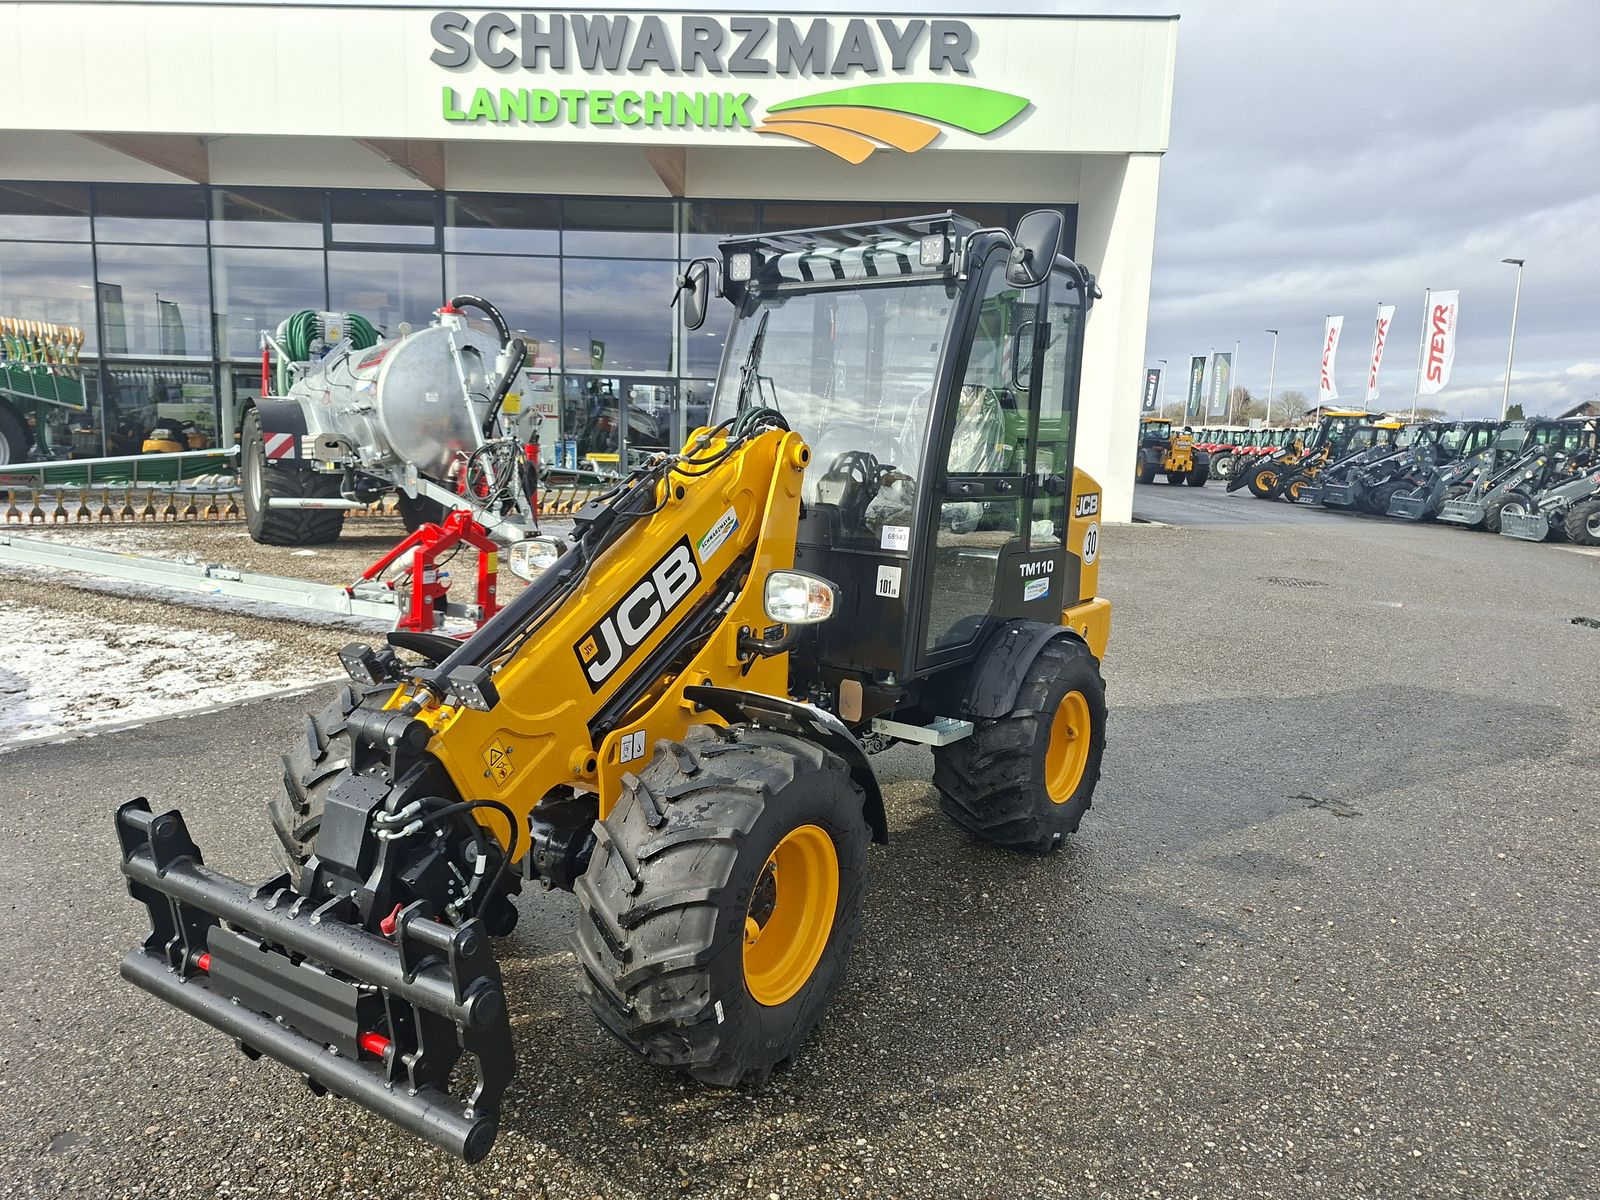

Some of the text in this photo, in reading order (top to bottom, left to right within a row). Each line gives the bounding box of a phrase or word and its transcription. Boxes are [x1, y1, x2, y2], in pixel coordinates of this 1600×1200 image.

[429, 10, 976, 75] SCHWARZMAYR
[441, 86, 754, 128] LANDTECHNIK
[1320, 327, 1338, 391] STEYR
[1369, 318, 1388, 389] STEYR
[1426, 304, 1449, 385] STEYR
[536, 403, 554, 413] NEU
[1075, 494, 1099, 516] JCB
[701, 516, 731, 549] SCHWARZMAYR
[1085, 530, 1097, 556] 30
[880, 579, 892, 594] 101
[1019, 560, 1054, 577] TM110
[588, 545, 697, 683] JCB
